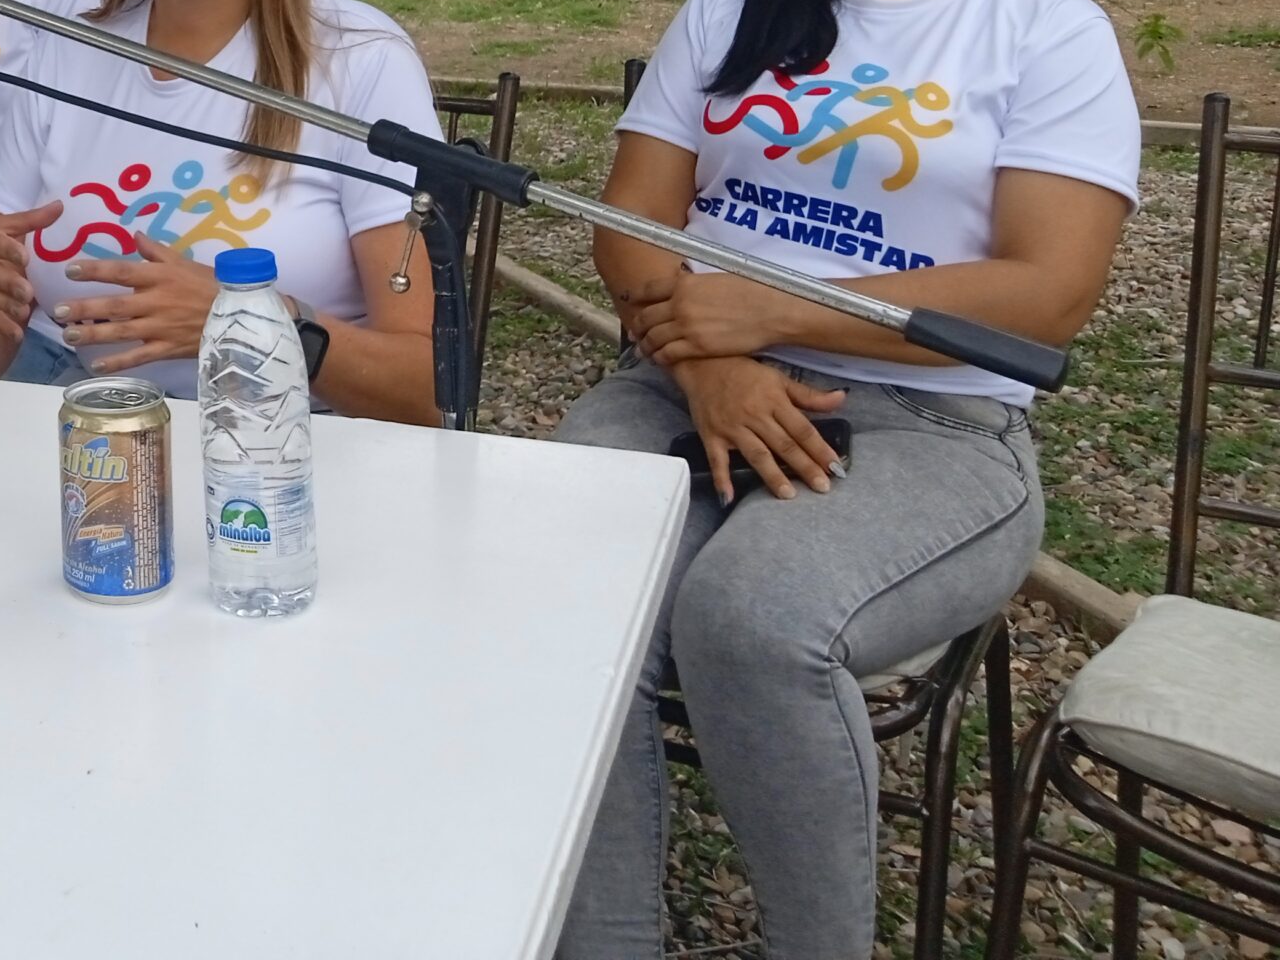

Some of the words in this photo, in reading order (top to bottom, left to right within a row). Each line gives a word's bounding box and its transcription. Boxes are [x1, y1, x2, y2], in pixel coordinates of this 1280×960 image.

[694, 197, 725, 218] DE
[724, 202, 759, 231] LA
[724, 178, 884, 239] CARRERA
[63, 444, 124, 480] altín
[219, 523, 271, 543] minalba
[71, 568, 84, 580] 250
[84, 573, 96, 583] ml
